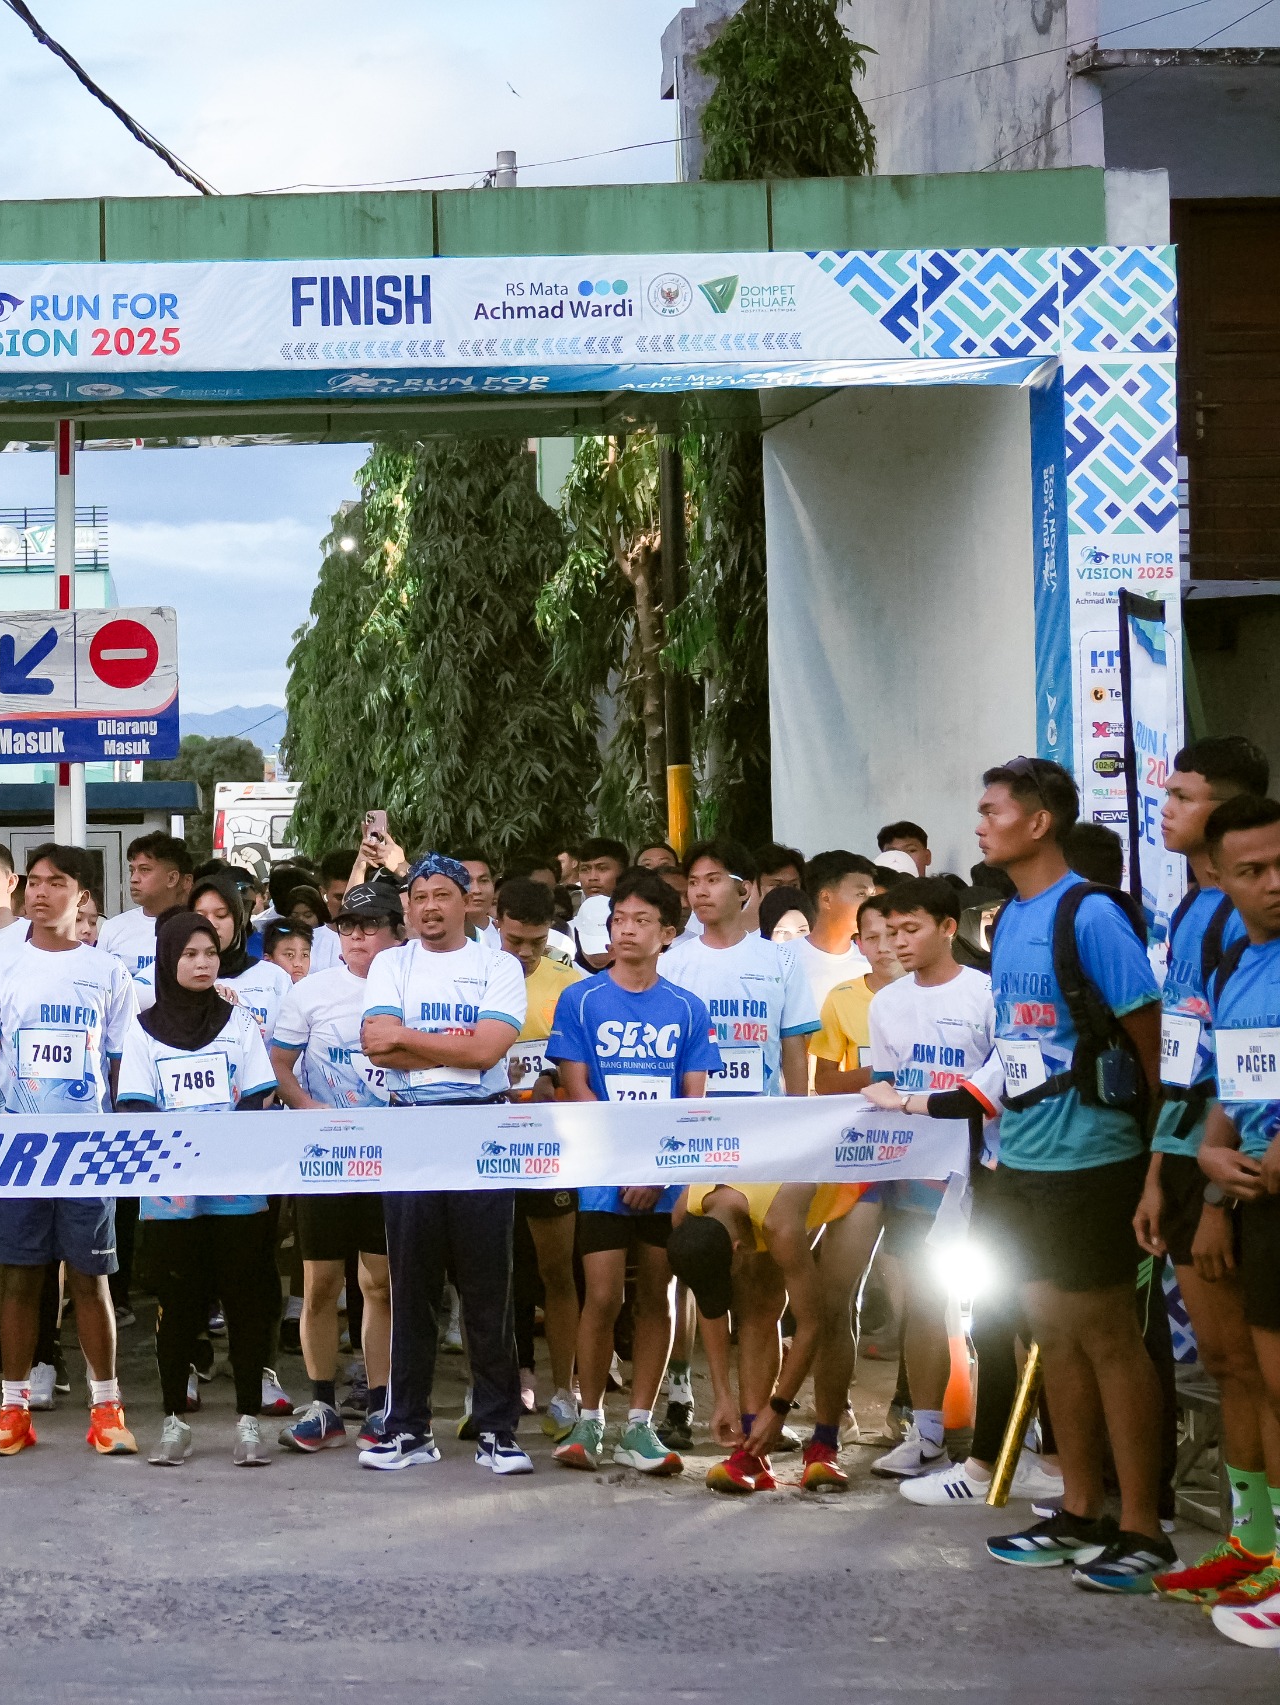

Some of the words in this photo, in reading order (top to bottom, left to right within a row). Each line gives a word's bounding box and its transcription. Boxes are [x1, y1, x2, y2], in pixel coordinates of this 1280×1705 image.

[506, 281, 524, 296] RS
[529, 281, 569, 297] Mata
[740, 285, 795, 296] DOMPET
[30, 294, 101, 322] RUN
[112, 293, 179, 320] FOR
[291, 274, 432, 327] FINISH
[473, 299, 564, 321] Achmad
[569, 298, 633, 320] Wardi
[740, 297, 796, 308] DHUAFA
[661, 307, 680, 315] BWI
[90, 327, 181, 358] 2025
[403, 375, 473, 387] RUN
[484, 375, 550, 385] FOR
[1113, 553, 1141, 564] RUN
[1146, 553, 1173, 564] FOR
[1076, 567, 1133, 579] VISION
[1138, 567, 1174, 579] 2025
[97, 719, 158, 739] Dilarang
[1135, 720, 1158, 755] RUN
[104, 739, 151, 757] Masuk
[1022, 972, 1053, 997] FOR
[40, 1003, 71, 1024] RUN
[75, 1005, 98, 1029] FOR
[421, 1002, 451, 1022] RUN
[709, 1000, 738, 1017] RUN
[742, 999, 767, 1018] FOR
[1013, 1002, 1057, 1027] 2025
[733, 1022, 768, 1042] 2025
[32, 1044, 72, 1064] 7403
[1237, 1053, 1277, 1073] PACER
[624, 1061, 657, 1070] RUNNING
[171, 1070, 215, 1092] 7486
[688, 1137, 714, 1152] RUN
[717, 1136, 740, 1151] FOR
[866, 1129, 890, 1144] RUN
[892, 1129, 914, 1145] FOR
[332, 1145, 357, 1159] RUN
[360, 1145, 383, 1159] FOR
[509, 1142, 534, 1157] RUN
[538, 1141, 561, 1157] FOR
[834, 1145, 875, 1162] VISION
[877, 1145, 910, 1161] 2025
[476, 1158, 521, 1175] VISION
[524, 1157, 560, 1175] 2025
[655, 1153, 700, 1167] VISION
[704, 1151, 741, 1164] 2025
[299, 1160, 343, 1177] VISION
[347, 1160, 382, 1177] 2025
